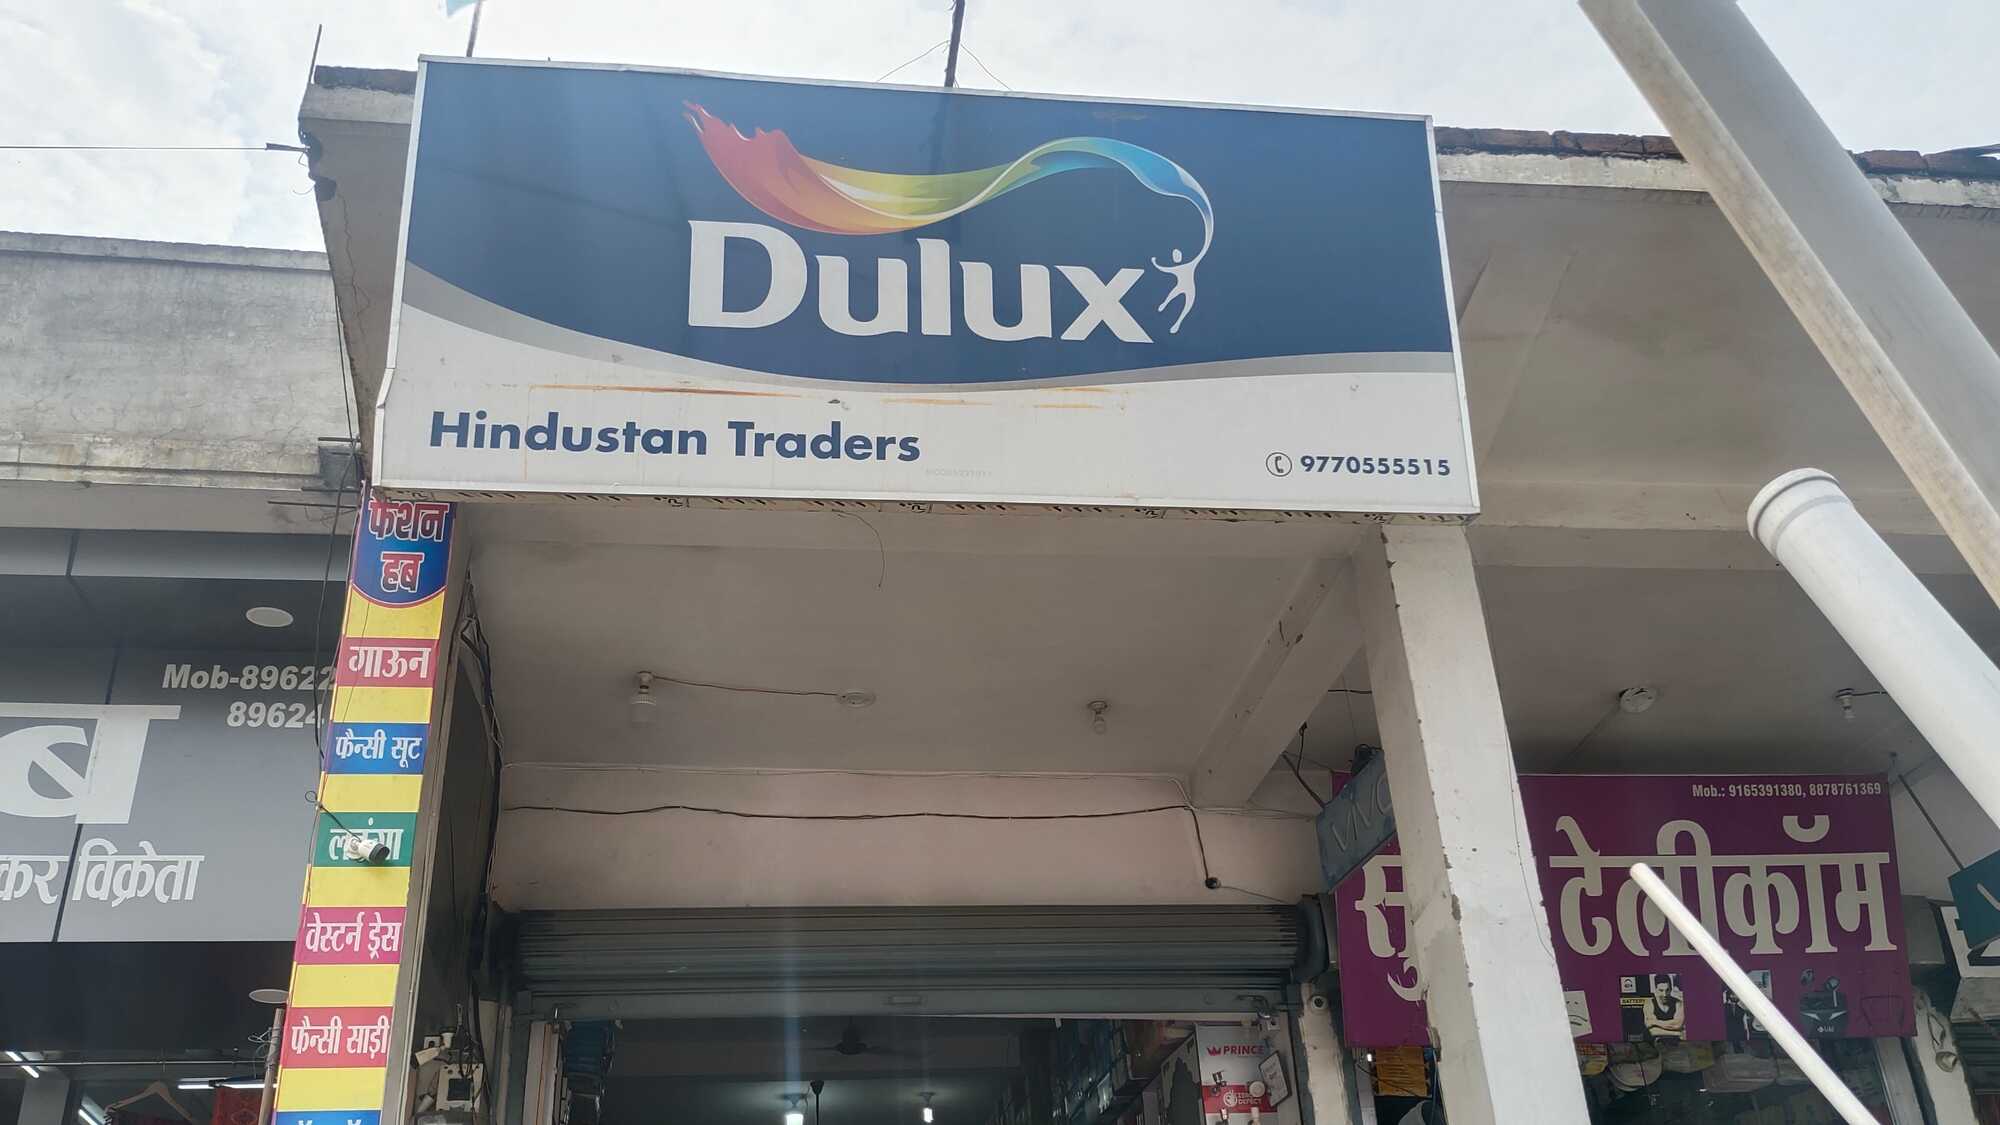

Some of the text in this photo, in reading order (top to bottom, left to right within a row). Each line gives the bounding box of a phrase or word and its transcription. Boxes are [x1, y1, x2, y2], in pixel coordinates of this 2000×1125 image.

[688, 220, 1154, 344] Dulux
[429, 410, 921, 462] Hindustan Traders
[1300, 455, 1451, 476] 9770555515
[380, 551, 425, 593] हब
[348, 646, 432, 679] गाऊन
[335, 728, 423, 768] फैन्सी सूट
[72, 838, 205, 908] विक्रेता
[1549, 815, 1898, 956] टेलीकॉम
[305, 911, 402, 960] वेस्टर्न ड्रेस
[291, 1015, 390, 1060] फैन्सी साड़ी
[1223, 1045, 1264, 1055] PRINCE
